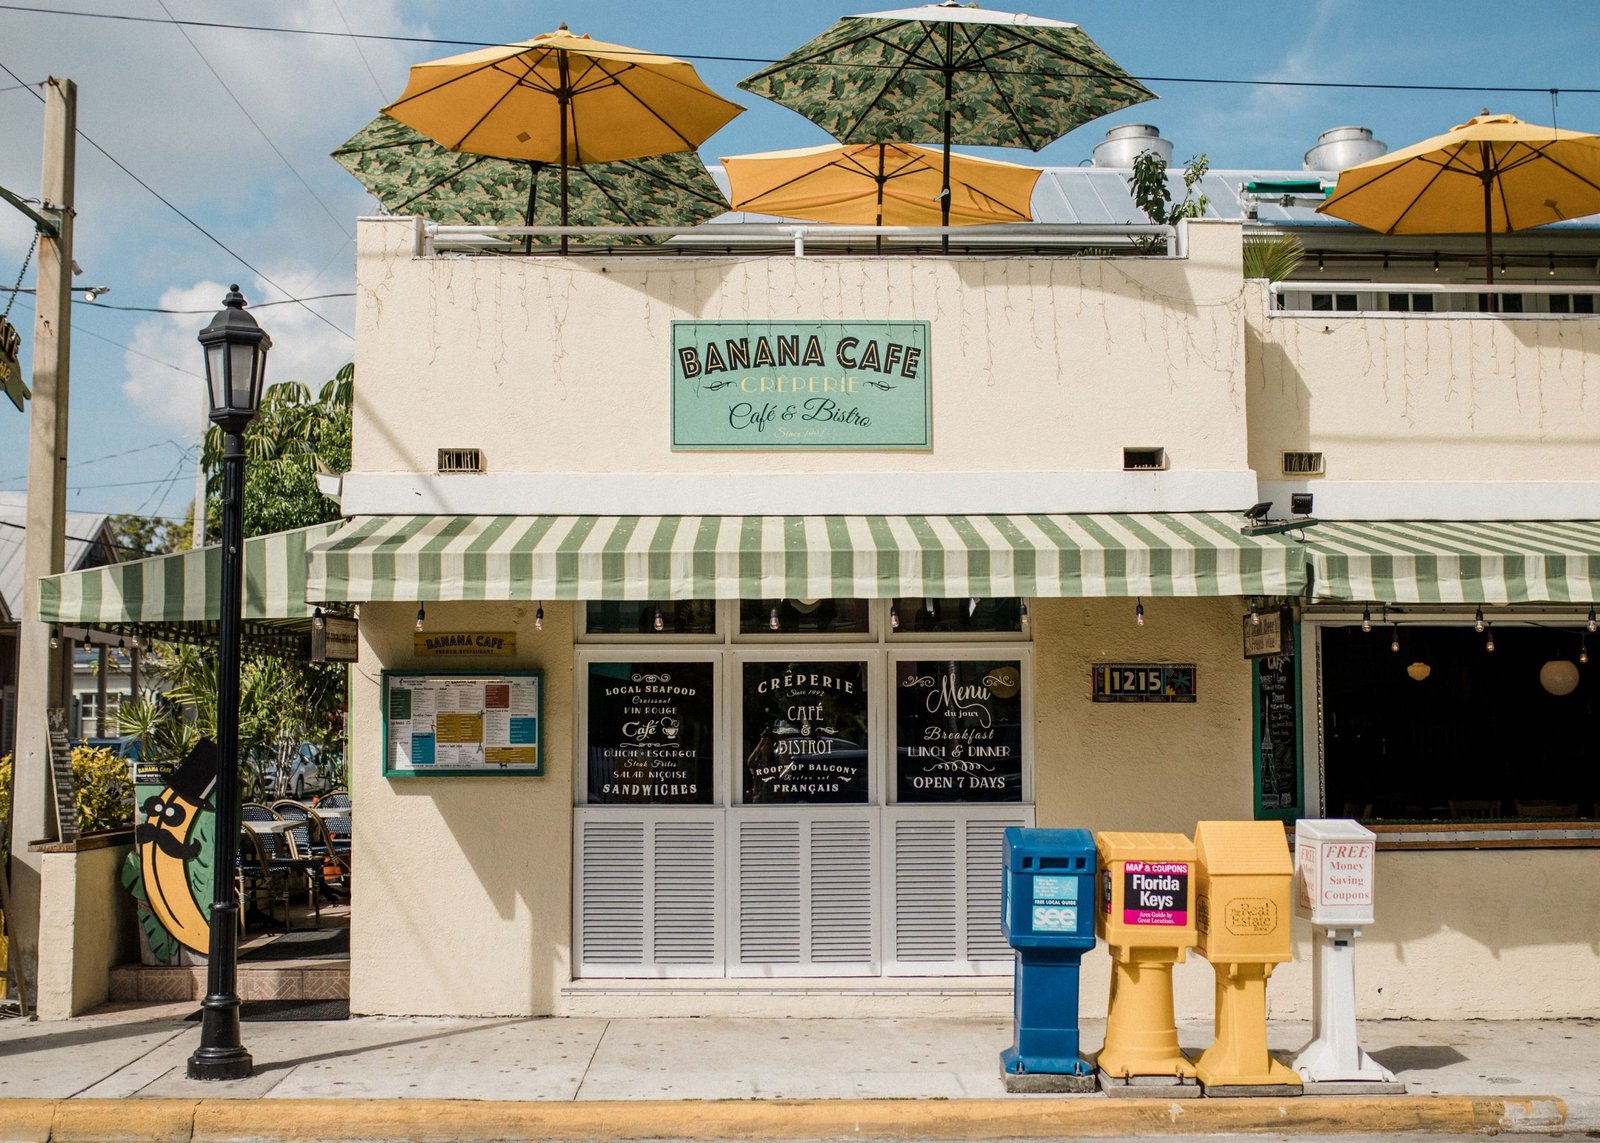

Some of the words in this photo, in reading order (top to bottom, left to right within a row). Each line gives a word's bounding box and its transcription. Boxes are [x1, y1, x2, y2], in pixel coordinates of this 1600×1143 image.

[678, 335, 825, 379] BANANA
[836, 336, 922, 379] CAFE
[739, 374, 860, 393] CRÊPERIE
[728, 402, 776, 432] Café
[781, 405, 796, 421] &
[801, 397, 872, 428] Bistro
[426, 634, 473, 650] BANANA
[476, 635, 505, 649] CAFE
[757, 669, 854, 694] CRÊPERIE
[1112, 671, 1161, 691] 1215
[605, 686, 641, 696] LOCAL
[645, 685, 696, 696] SEAFOOD
[786, 688, 806, 697] Since
[631, 695, 671, 704] Croissant
[926, 672, 992, 729] Menu
[787, 702, 824, 721] CAFÉ
[959, 710, 979, 719] jour
[622, 720, 659, 741] Café
[800, 724, 811, 736] &
[923, 726, 995, 744] Breakfast
[778, 740, 833, 754] BISTROT
[907, 746, 946, 757] LUNCH
[951, 745, 963, 757] &
[968, 746, 1011, 757] DINNER
[624, 759, 648, 768] Steak
[651, 759, 677, 768] Frites
[649, 771, 688, 781] NIÇOISE
[756, 764, 804, 776] ROOFTOP
[808, 764, 857, 775] BALCONY
[773, 784, 839, 794] FRANÇAIS
[913, 777, 953, 789] OPEN
[957, 777, 965, 788] 7
[969, 777, 1006, 789] DAYS
[602, 784, 698, 796] SANDWICHES
[1324, 845, 1370, 858] FREE
[1125, 863, 1143, 872] MAP
[1144, 864, 1151, 872] &
[1152, 864, 1188, 873] COUPONS
[1329, 861, 1364, 872] Money
[1132, 874, 1180, 891] Florida
[1329, 875, 1364, 886] Saving
[1140, 891, 1174, 910] Keys
[1324, 890, 1369, 902] Coupons
[1241, 903, 1269, 916] Real
[1033, 907, 1076, 926] see
[1231, 916, 1271, 927] Estate
